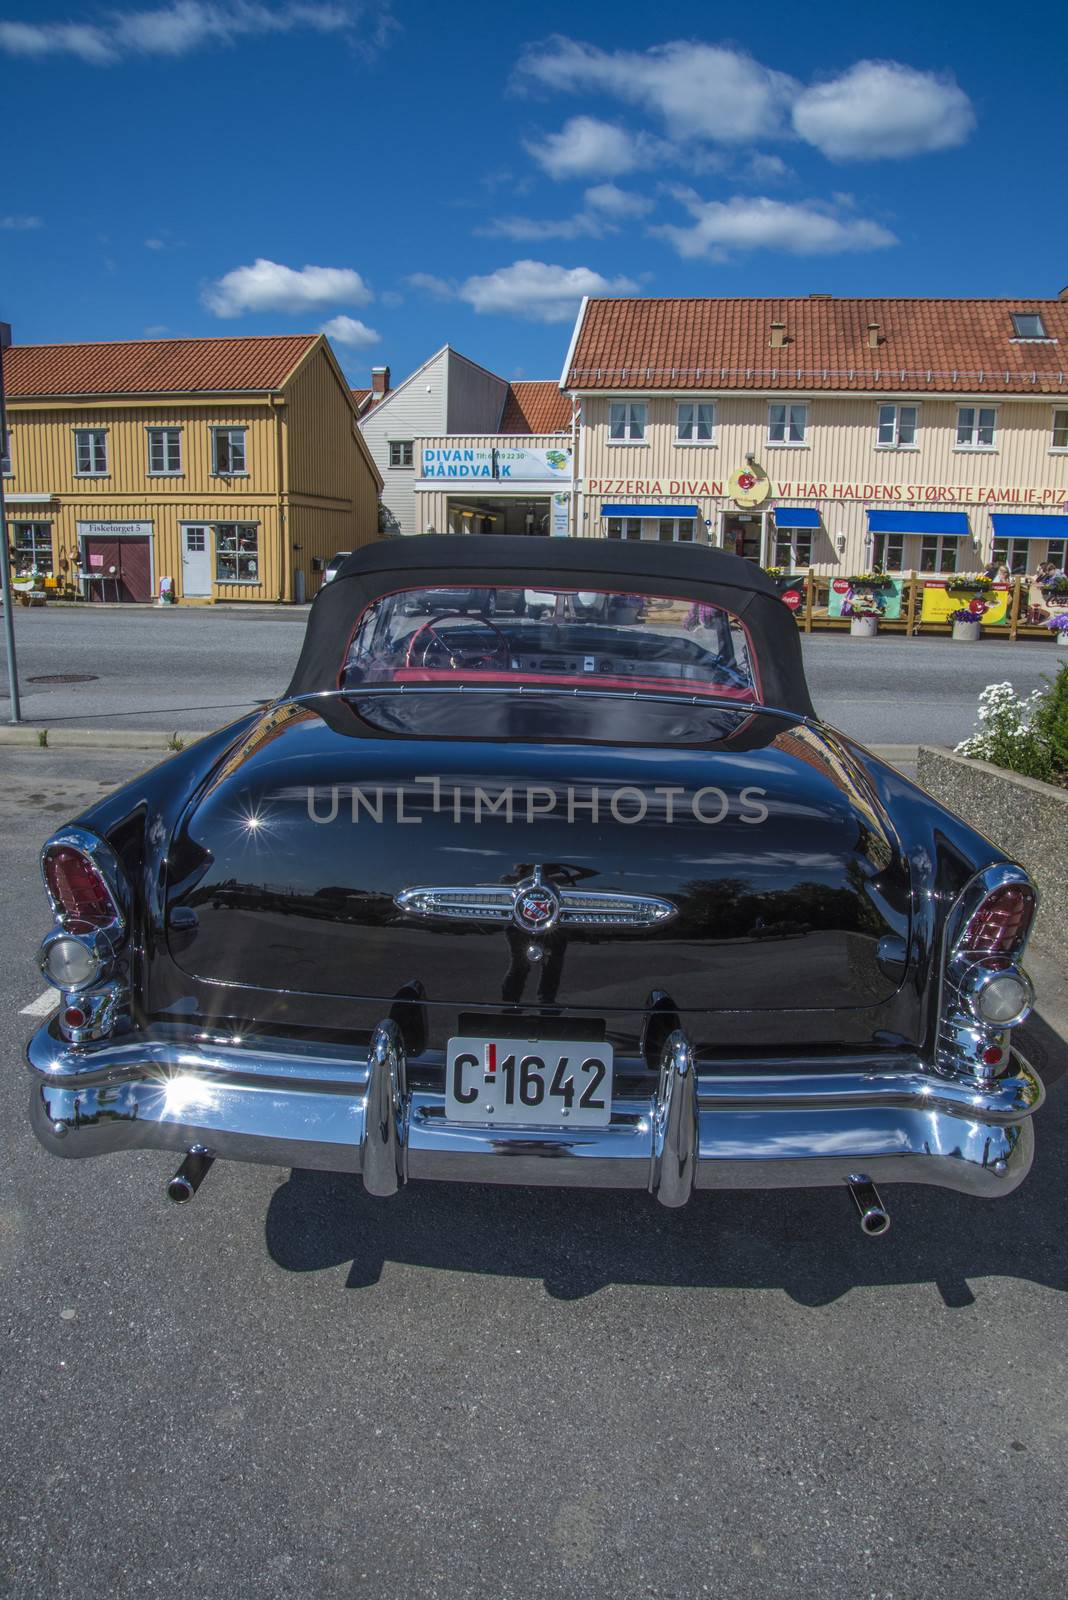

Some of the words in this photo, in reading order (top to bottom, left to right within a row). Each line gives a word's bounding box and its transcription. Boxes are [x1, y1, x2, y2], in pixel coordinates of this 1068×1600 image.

[424, 450, 474, 462] DIVAN
[588, 479, 663, 495] PIZZERIA
[669, 481, 723, 496] DIVAN
[777, 482, 791, 496] VI
[797, 483, 828, 498] HAR
[833, 483, 902, 500] HALDENS
[907, 485, 973, 502] STØRSTE
[89, 524, 134, 534] Fisketorget
[135, 524, 141, 532] 5
[453, 1052, 607, 1109] C-1642
